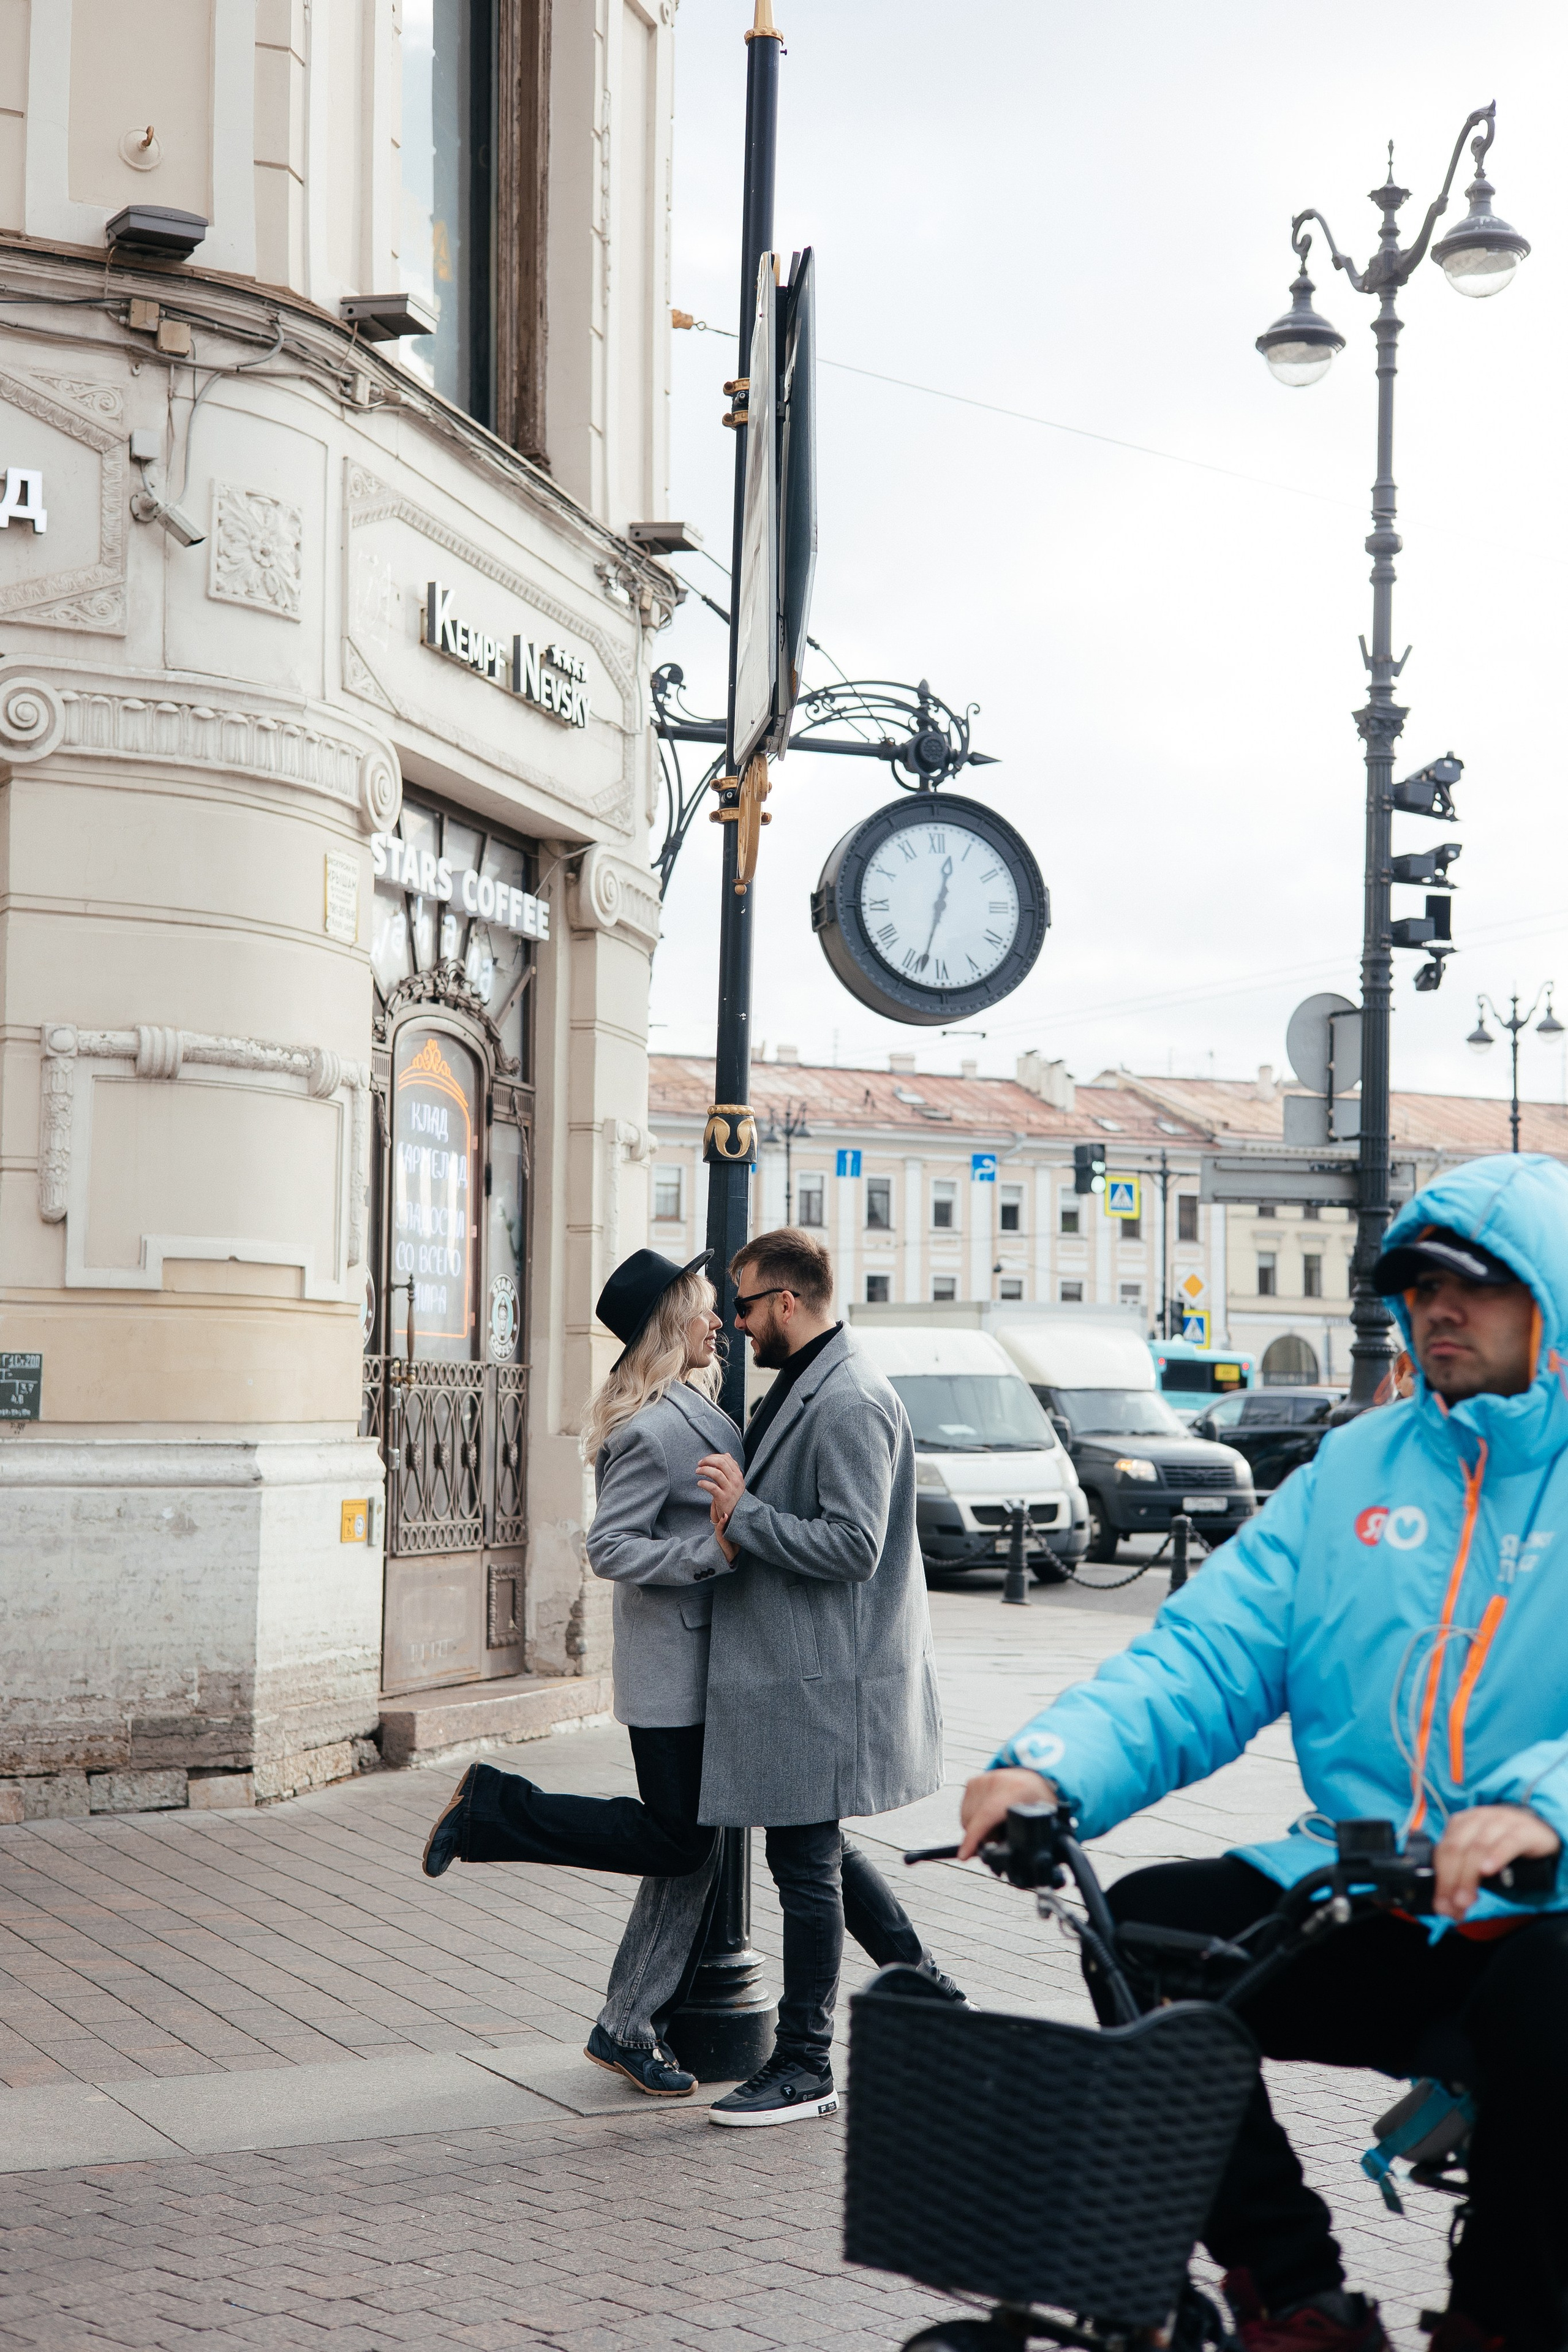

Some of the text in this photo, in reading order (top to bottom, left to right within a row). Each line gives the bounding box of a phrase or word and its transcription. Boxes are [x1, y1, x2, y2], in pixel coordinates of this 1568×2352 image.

[929, 833, 946, 854] XII
[370, 832, 453, 902] STARS
[461, 869, 550, 941] COFFEE
[411, 1101, 449, 1144] КЛАД
[398, 1141, 468, 1189] АРЕЛД
[395, 1234, 415, 1272] СО
